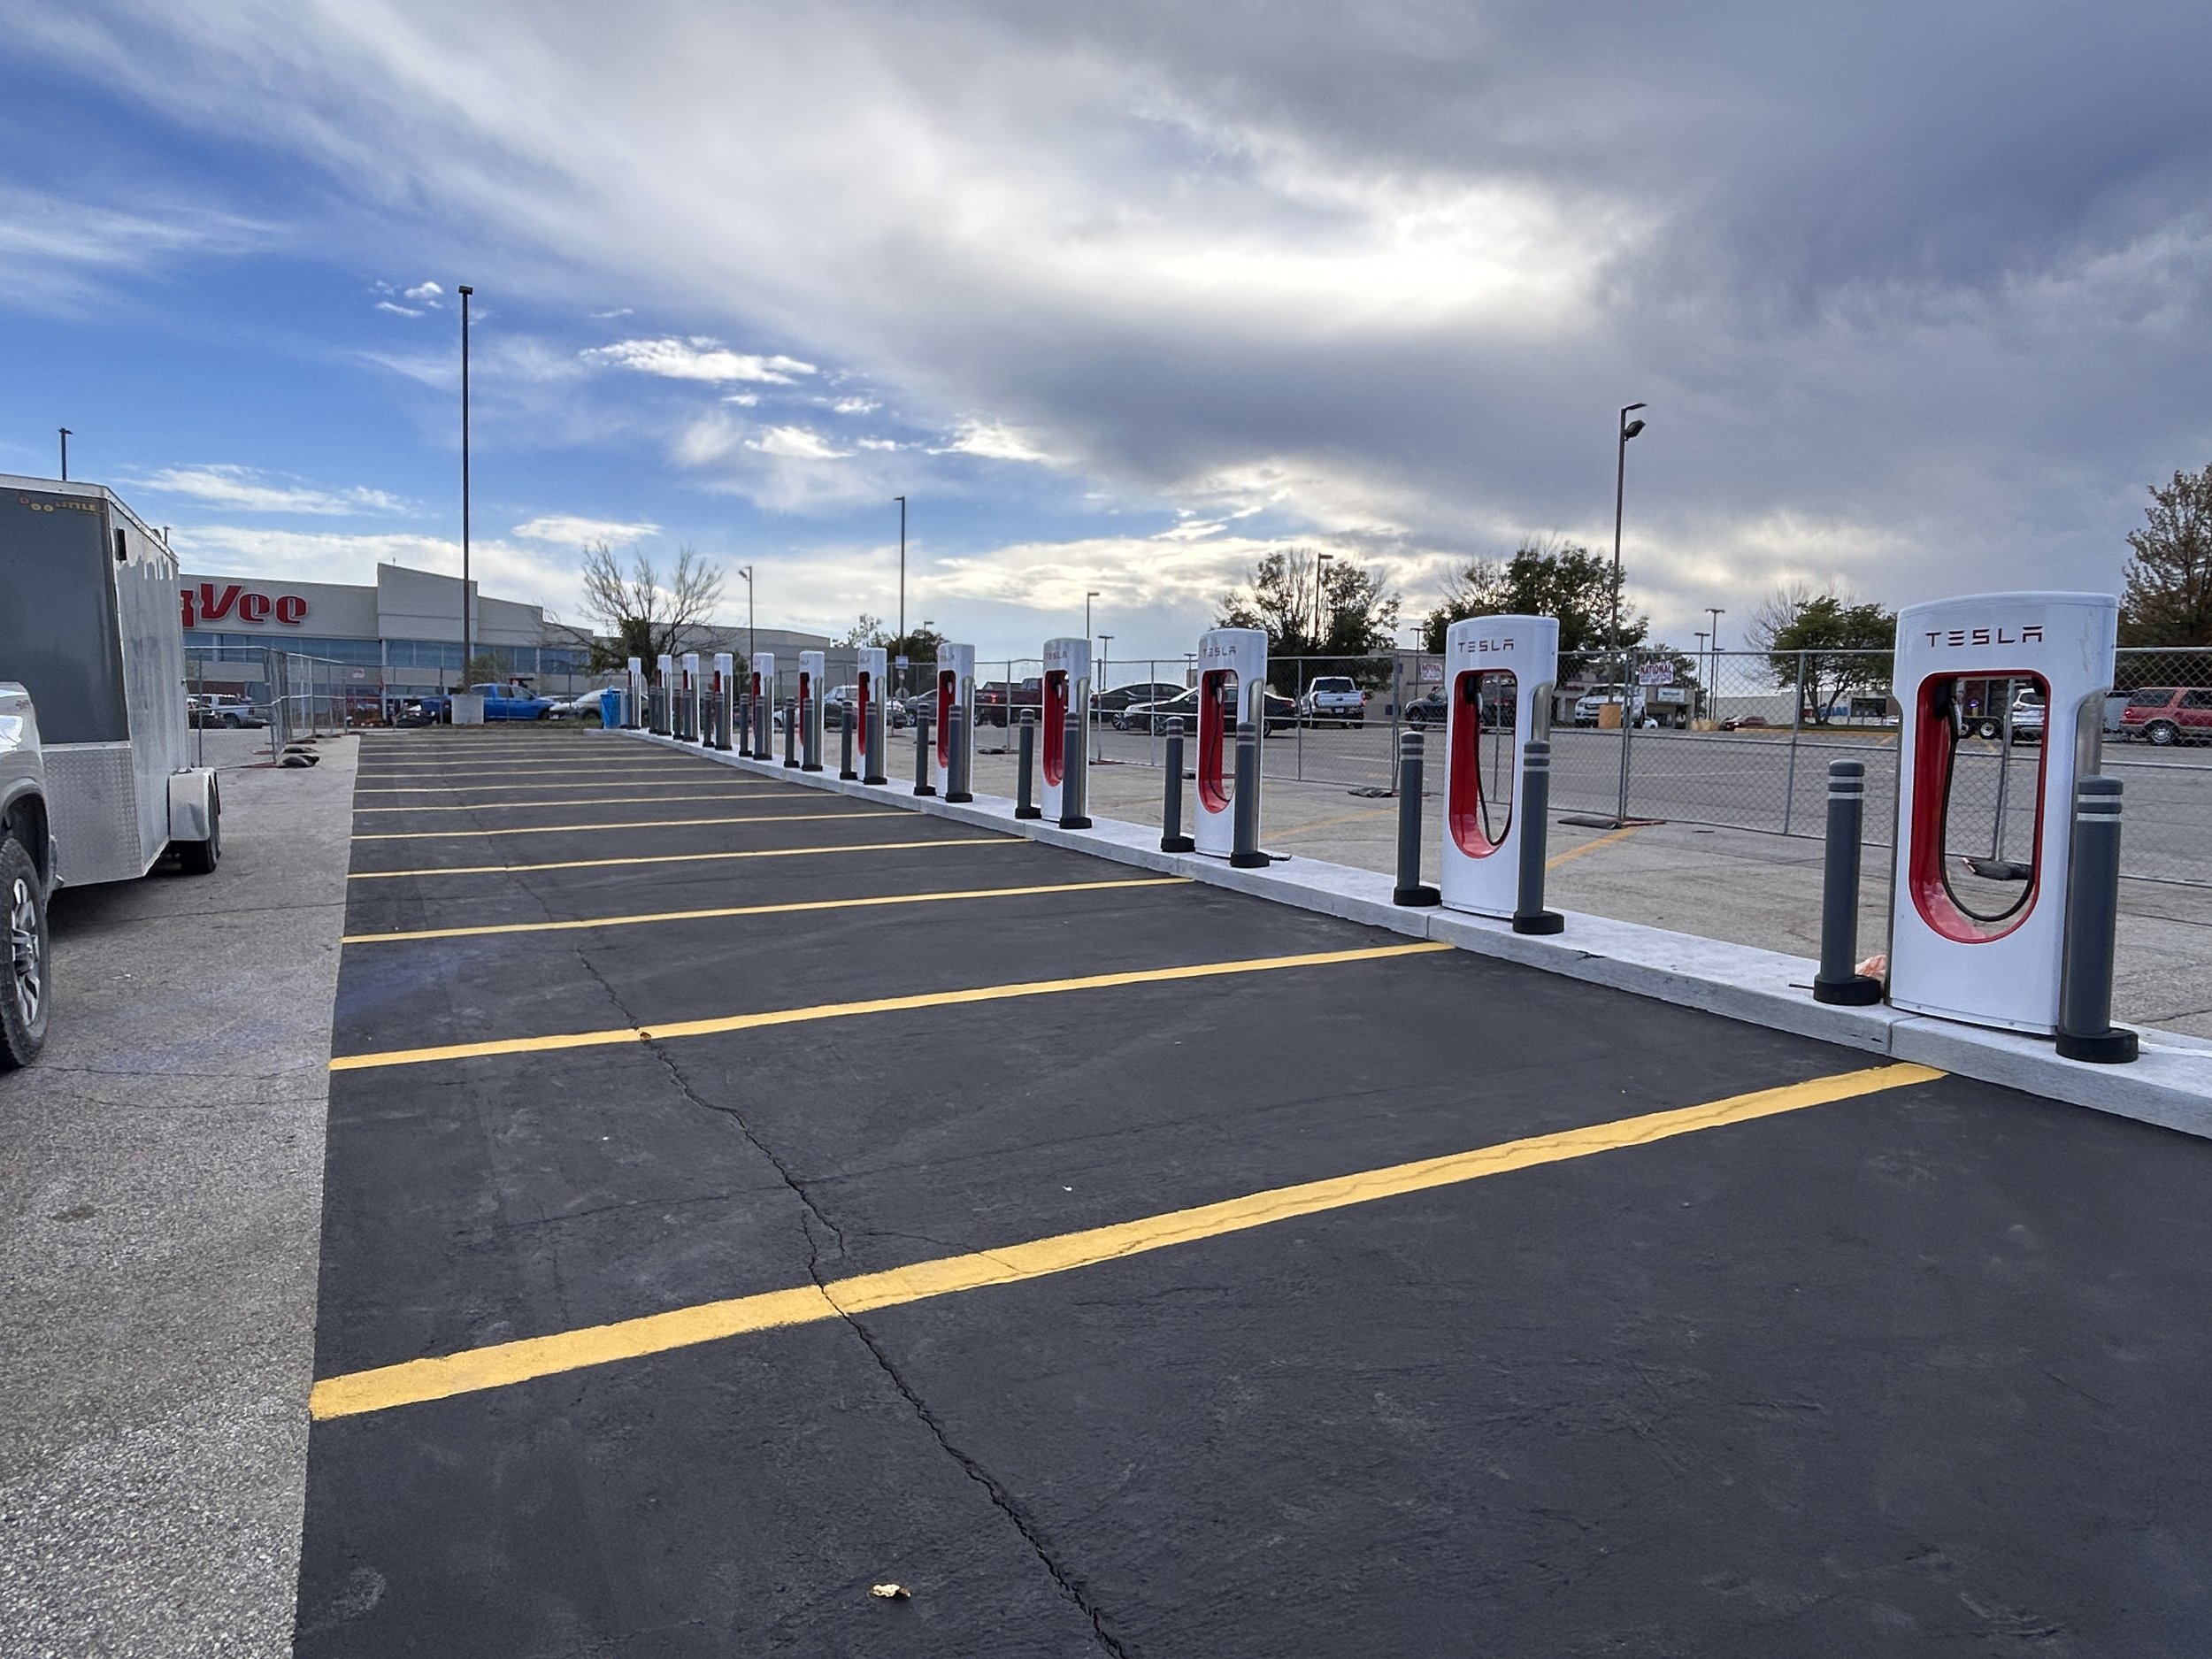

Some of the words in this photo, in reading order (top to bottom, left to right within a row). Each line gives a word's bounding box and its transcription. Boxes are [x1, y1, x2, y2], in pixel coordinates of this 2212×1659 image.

[1924, 625, 2044, 648] TESLA
[1202, 646, 1237, 657] TESLA
[1457, 639, 1515, 653] TESLA
